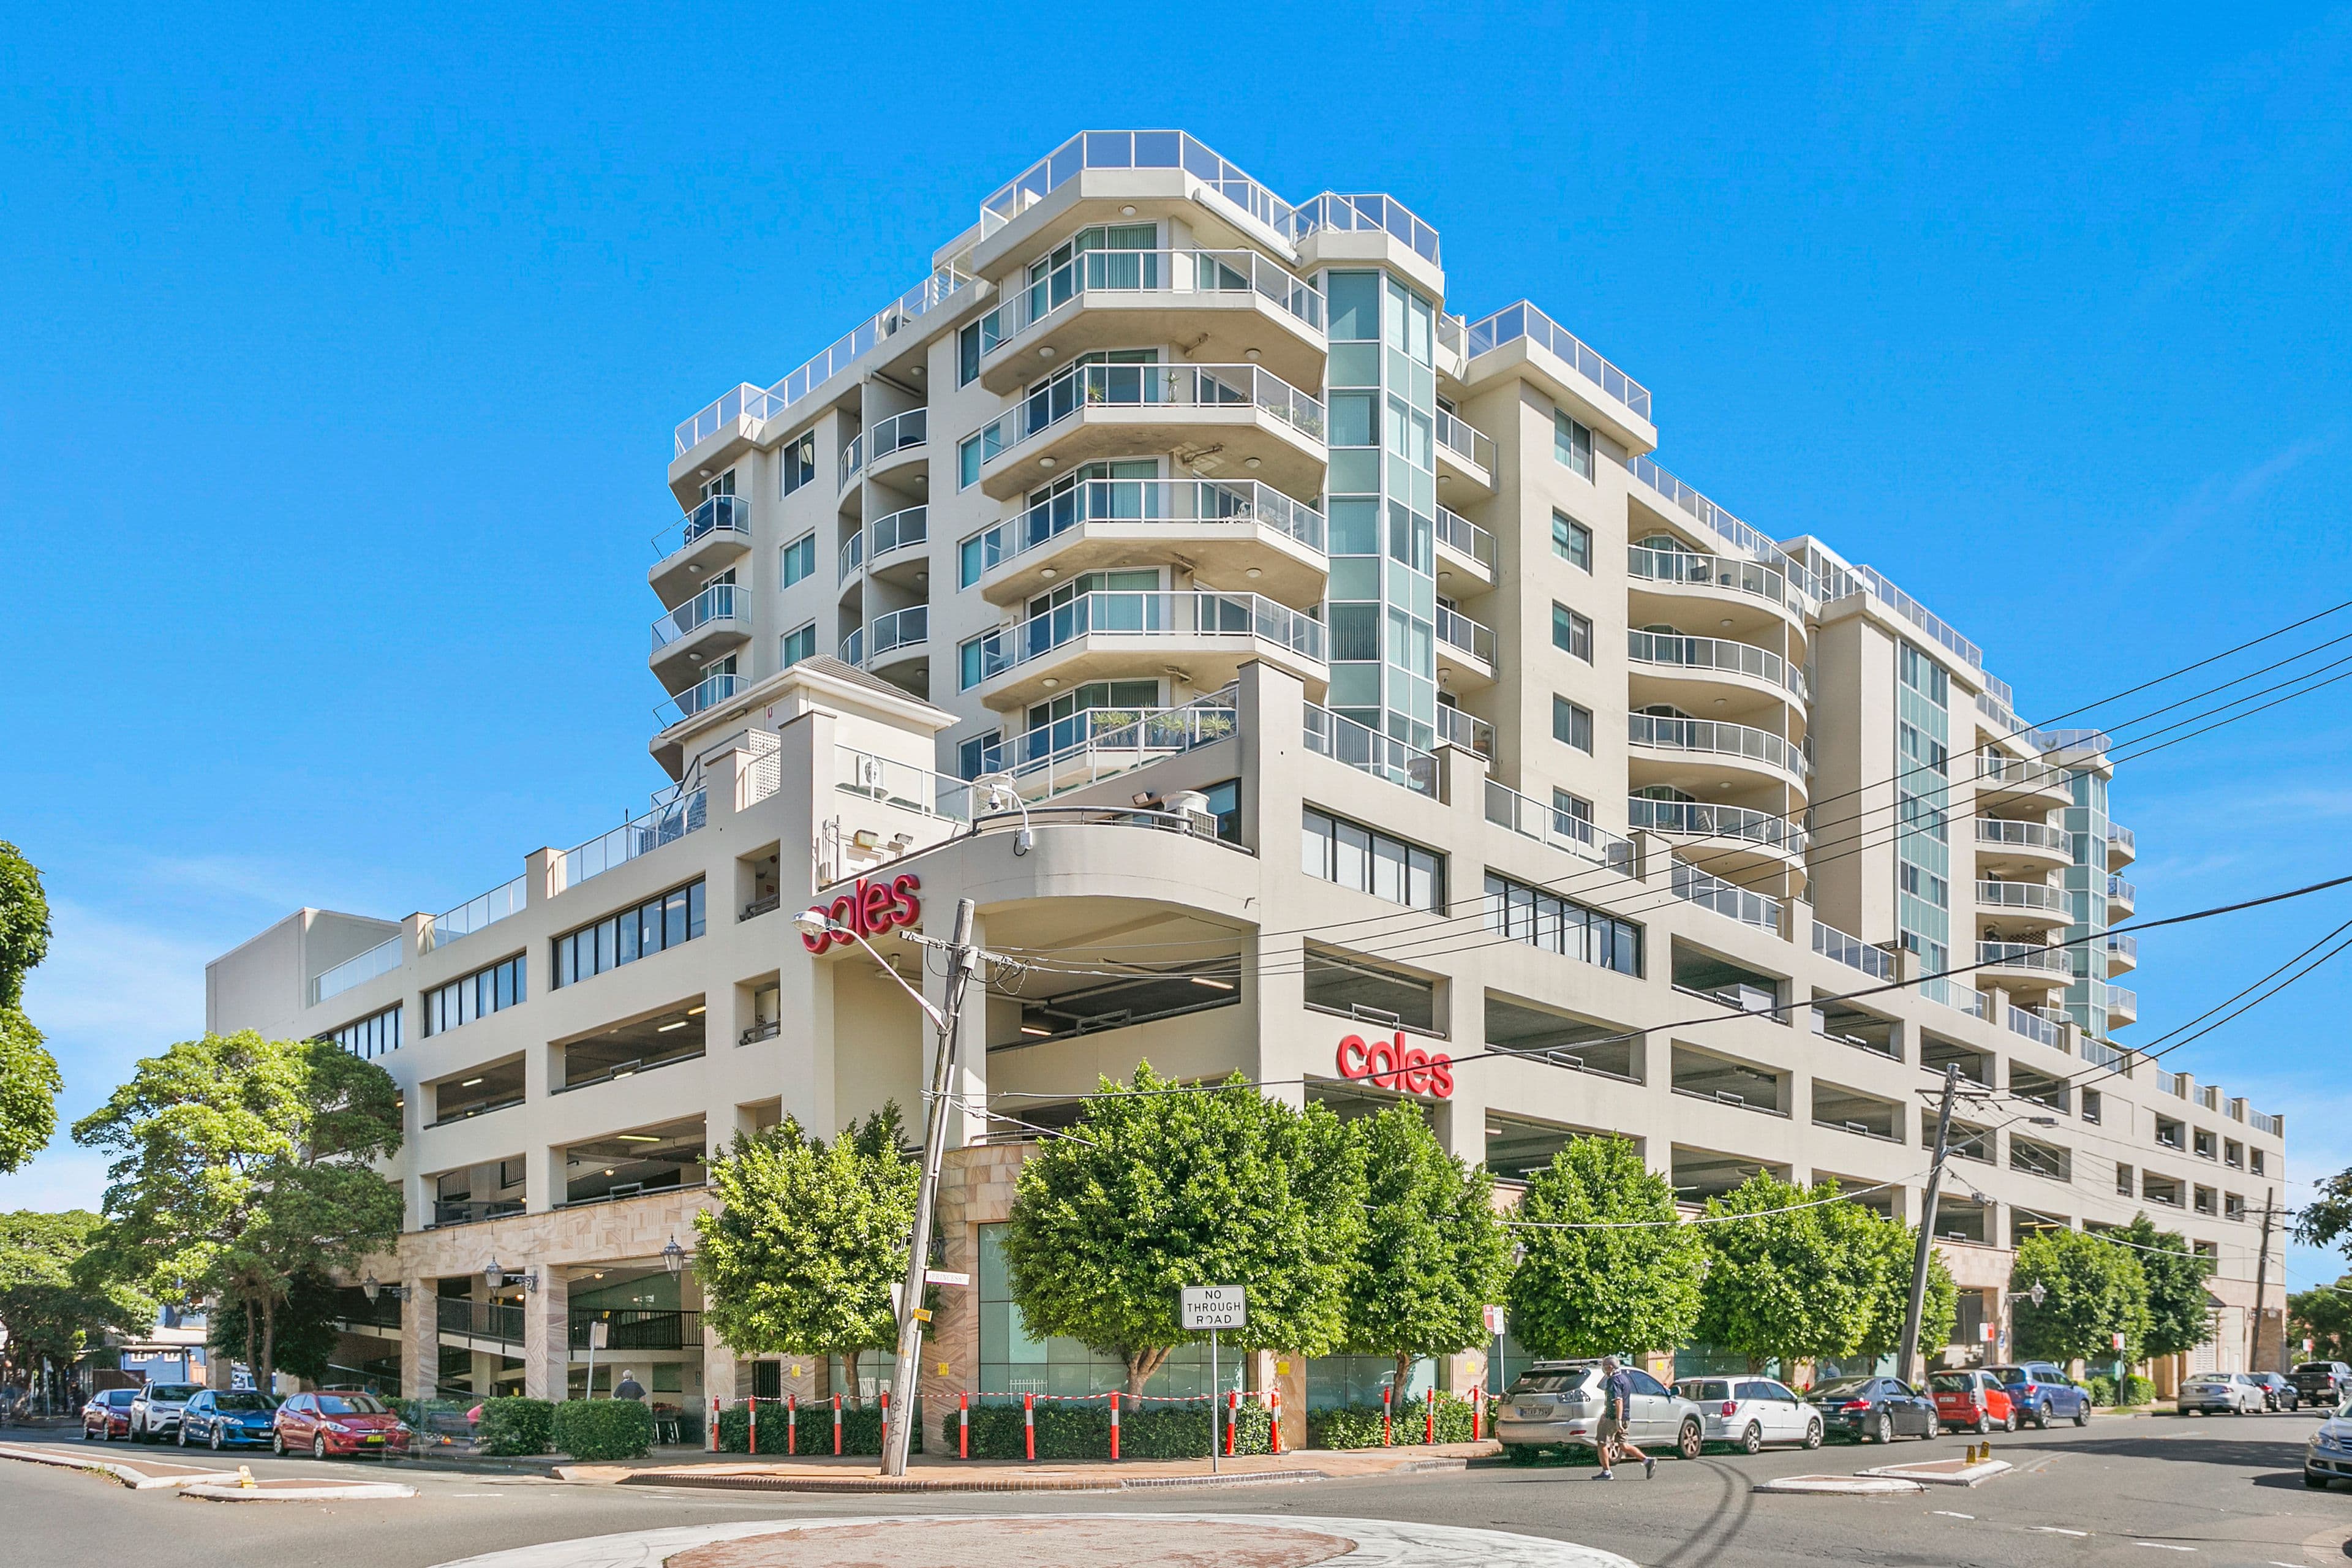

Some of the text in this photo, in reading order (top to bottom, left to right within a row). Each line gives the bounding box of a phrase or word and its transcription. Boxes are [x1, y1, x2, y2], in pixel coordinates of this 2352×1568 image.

[1338, 1031, 1454, 1098] coles
[1205, 1290, 1221, 1299] NO
[1187, 1302, 1240, 1312] THROUGH
[1196, 1314, 1232, 1325] ROAD
